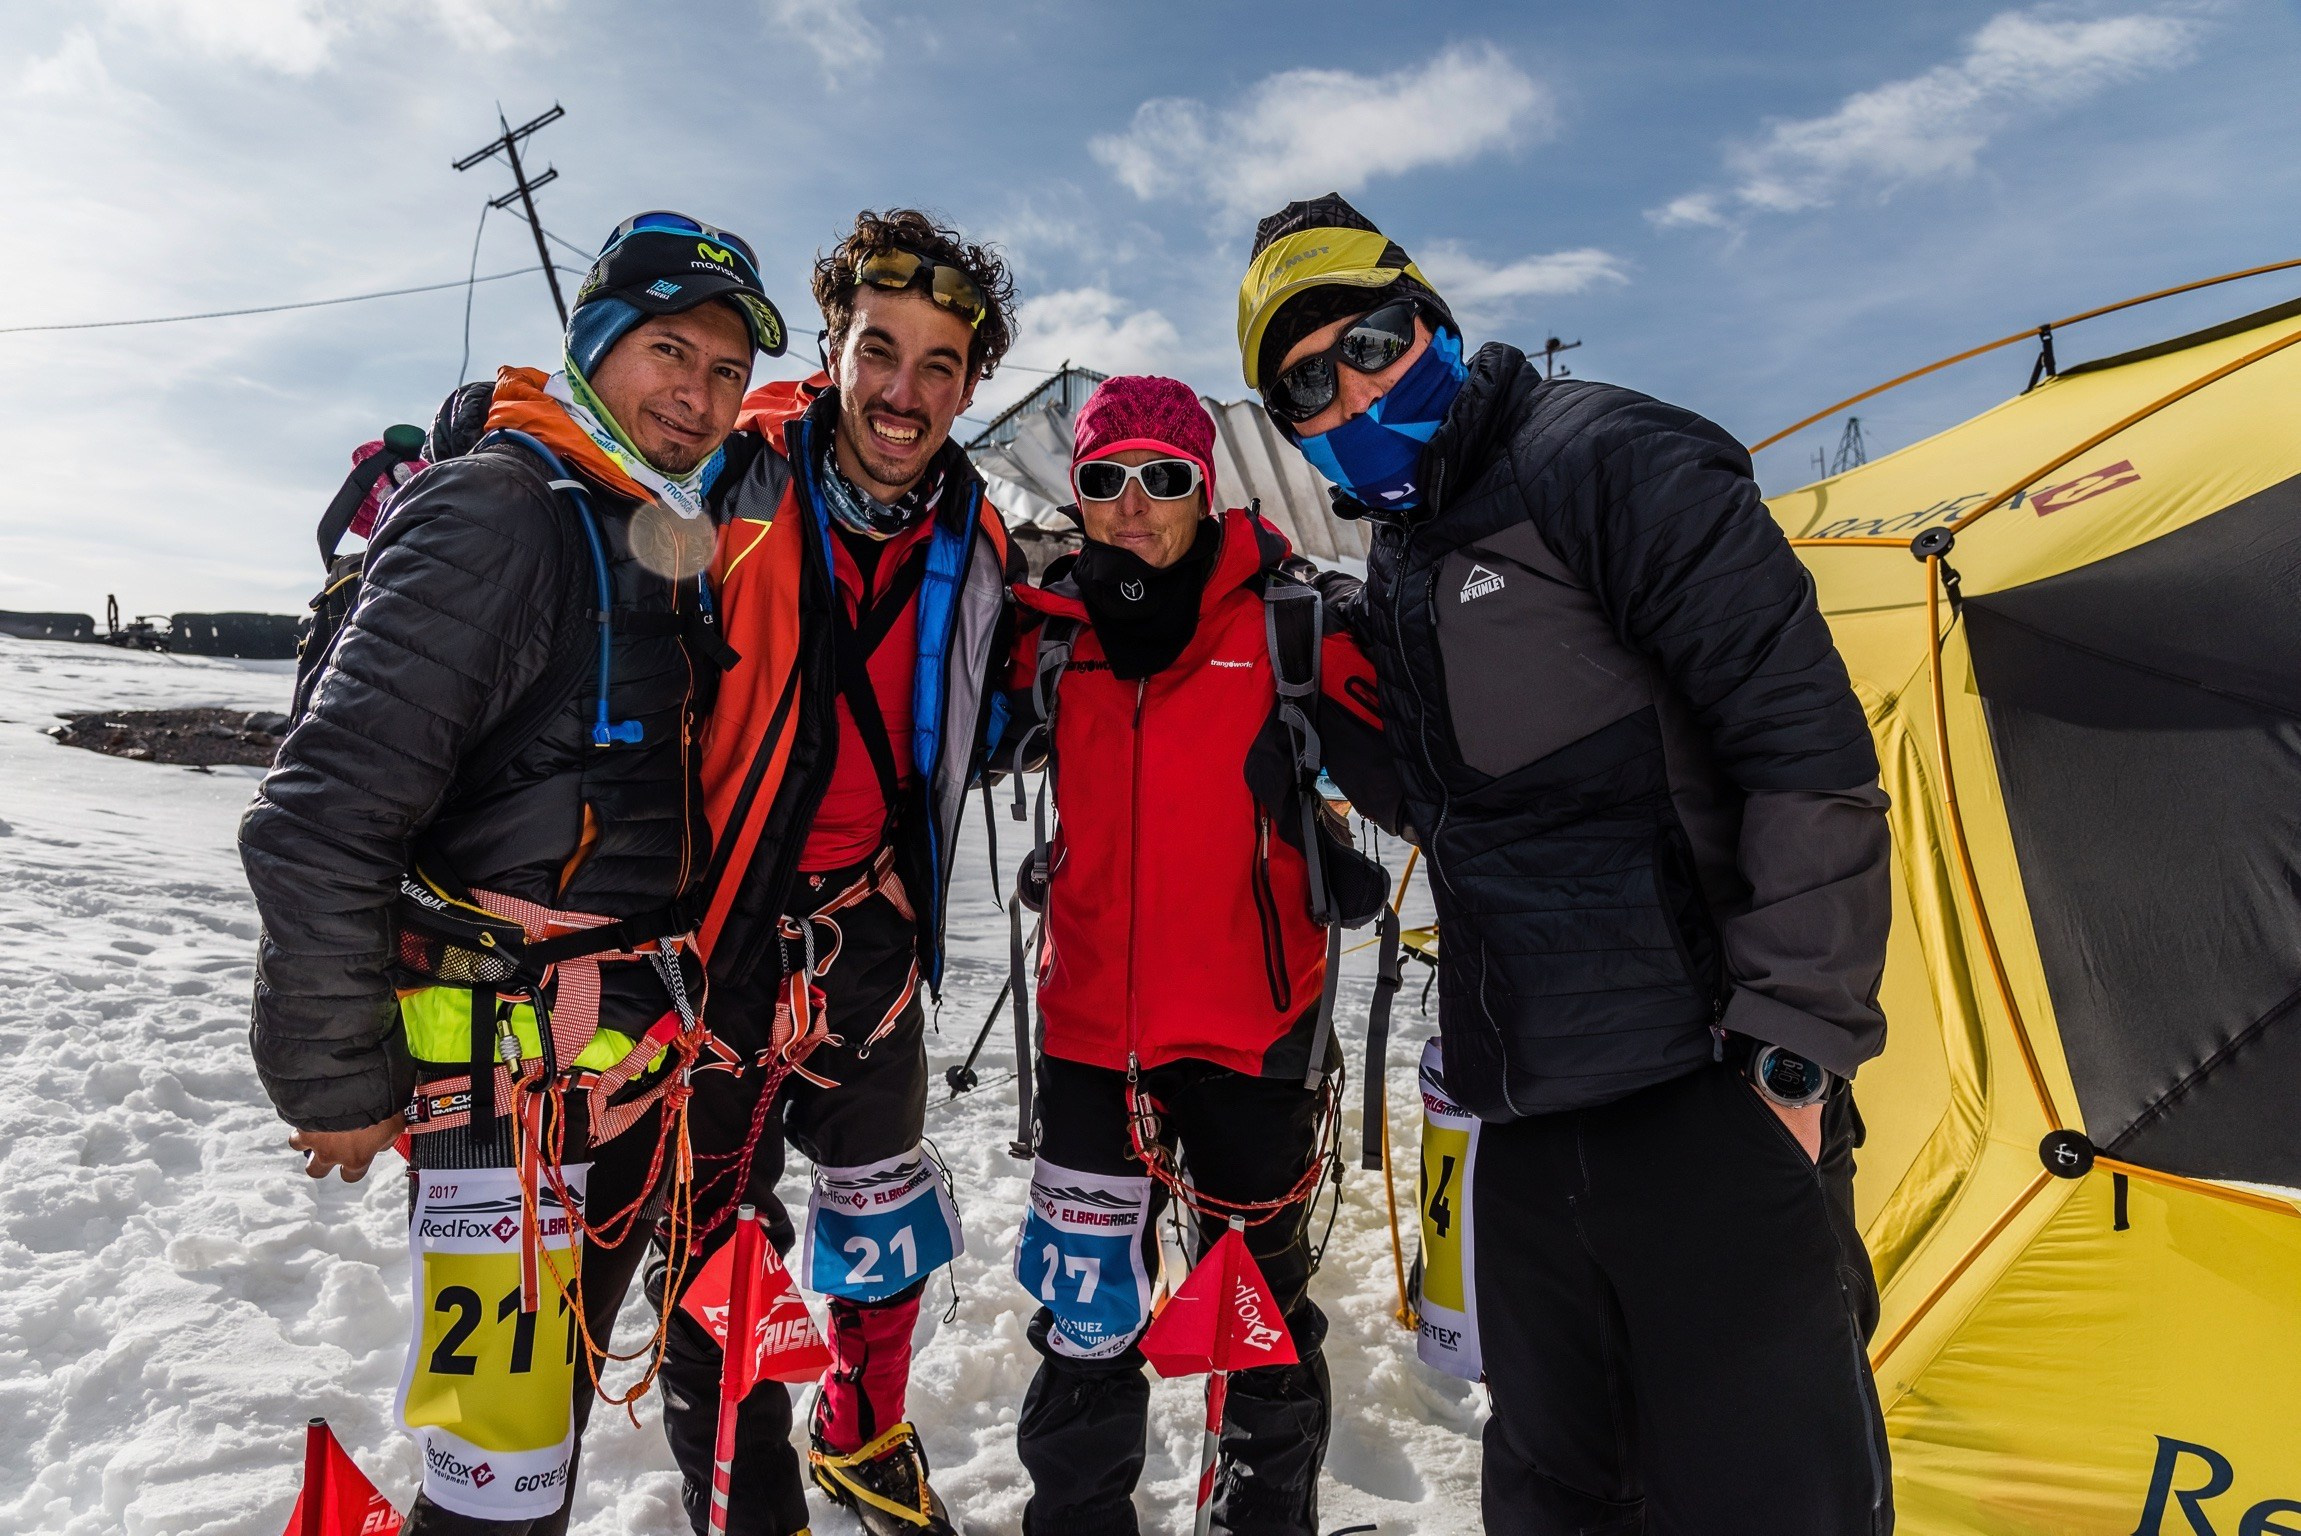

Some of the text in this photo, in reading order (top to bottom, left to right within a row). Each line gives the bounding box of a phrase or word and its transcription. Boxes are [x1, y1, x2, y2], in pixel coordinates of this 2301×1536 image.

[691, 261, 744, 285] movistar
[651, 280, 682, 296] TEAM
[662, 482, 695, 515] movistar
[428, 1185, 458, 1200] 2017
[1061, 1208, 1140, 1227] ELBRUSRACE
[418, 1219, 493, 1238] RedFox
[843, 1224, 918, 1285] 21
[1040, 1243, 1101, 1304] 17
[434, 1469, 469, 1487] equipment
